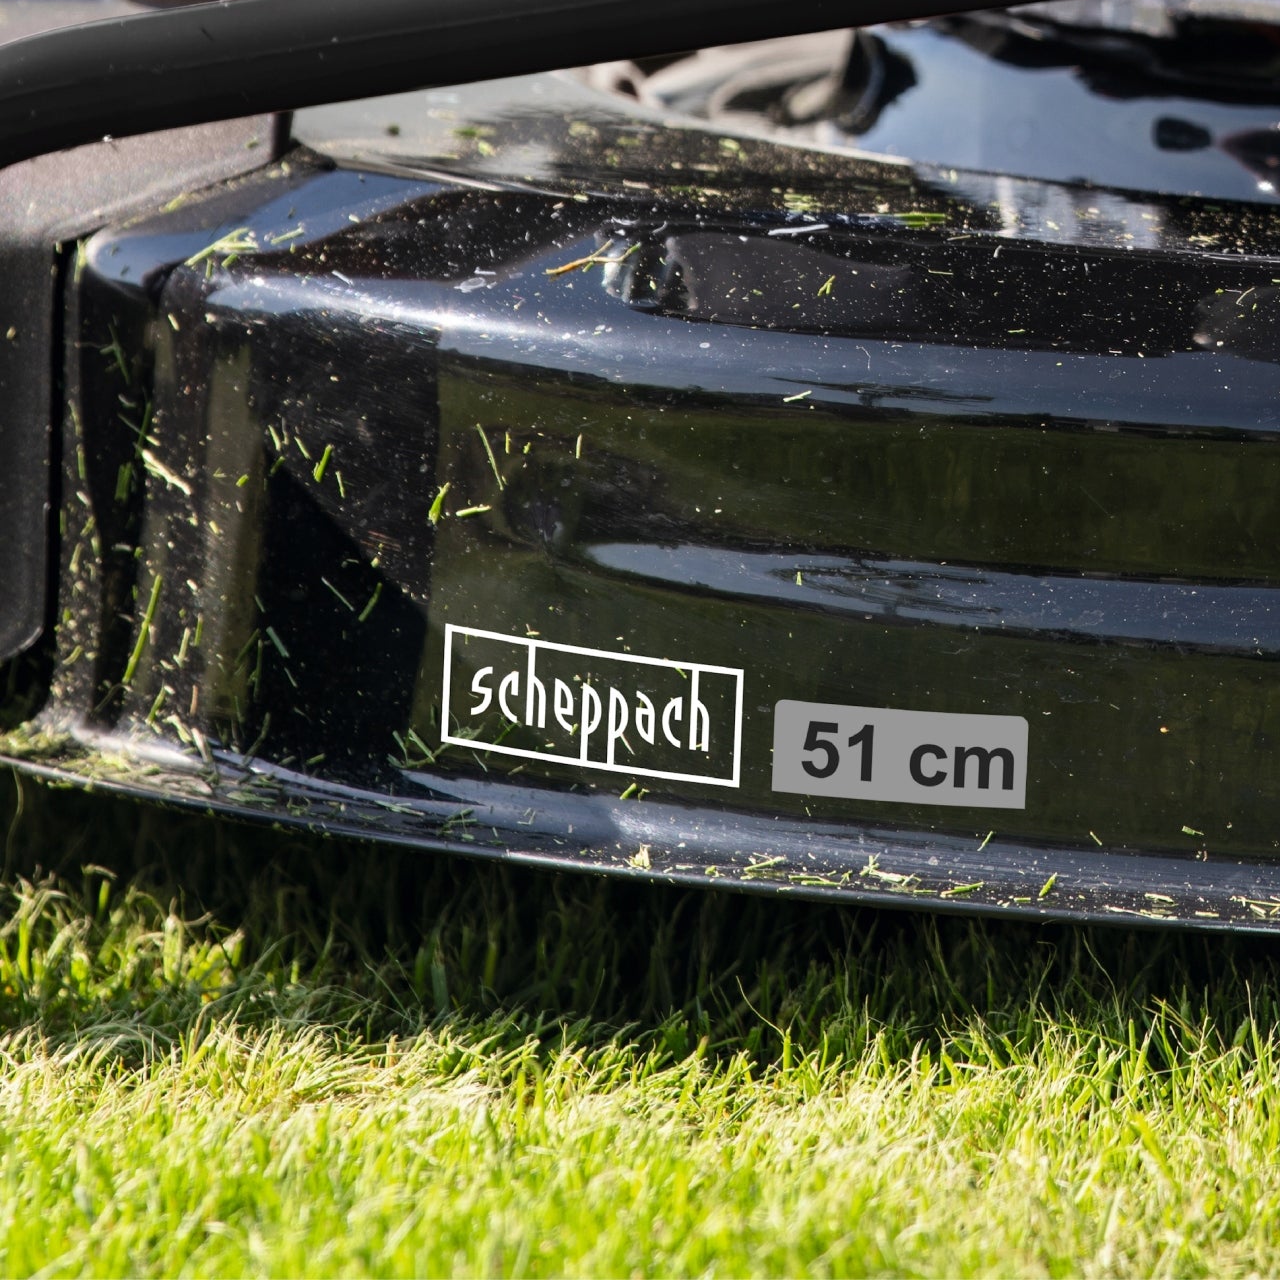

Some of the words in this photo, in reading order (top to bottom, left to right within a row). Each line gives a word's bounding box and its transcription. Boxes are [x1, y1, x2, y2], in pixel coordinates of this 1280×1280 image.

[470, 644, 711, 765] scheppach
[801, 720, 875, 783] 51
[909, 743, 1015, 791] cm
